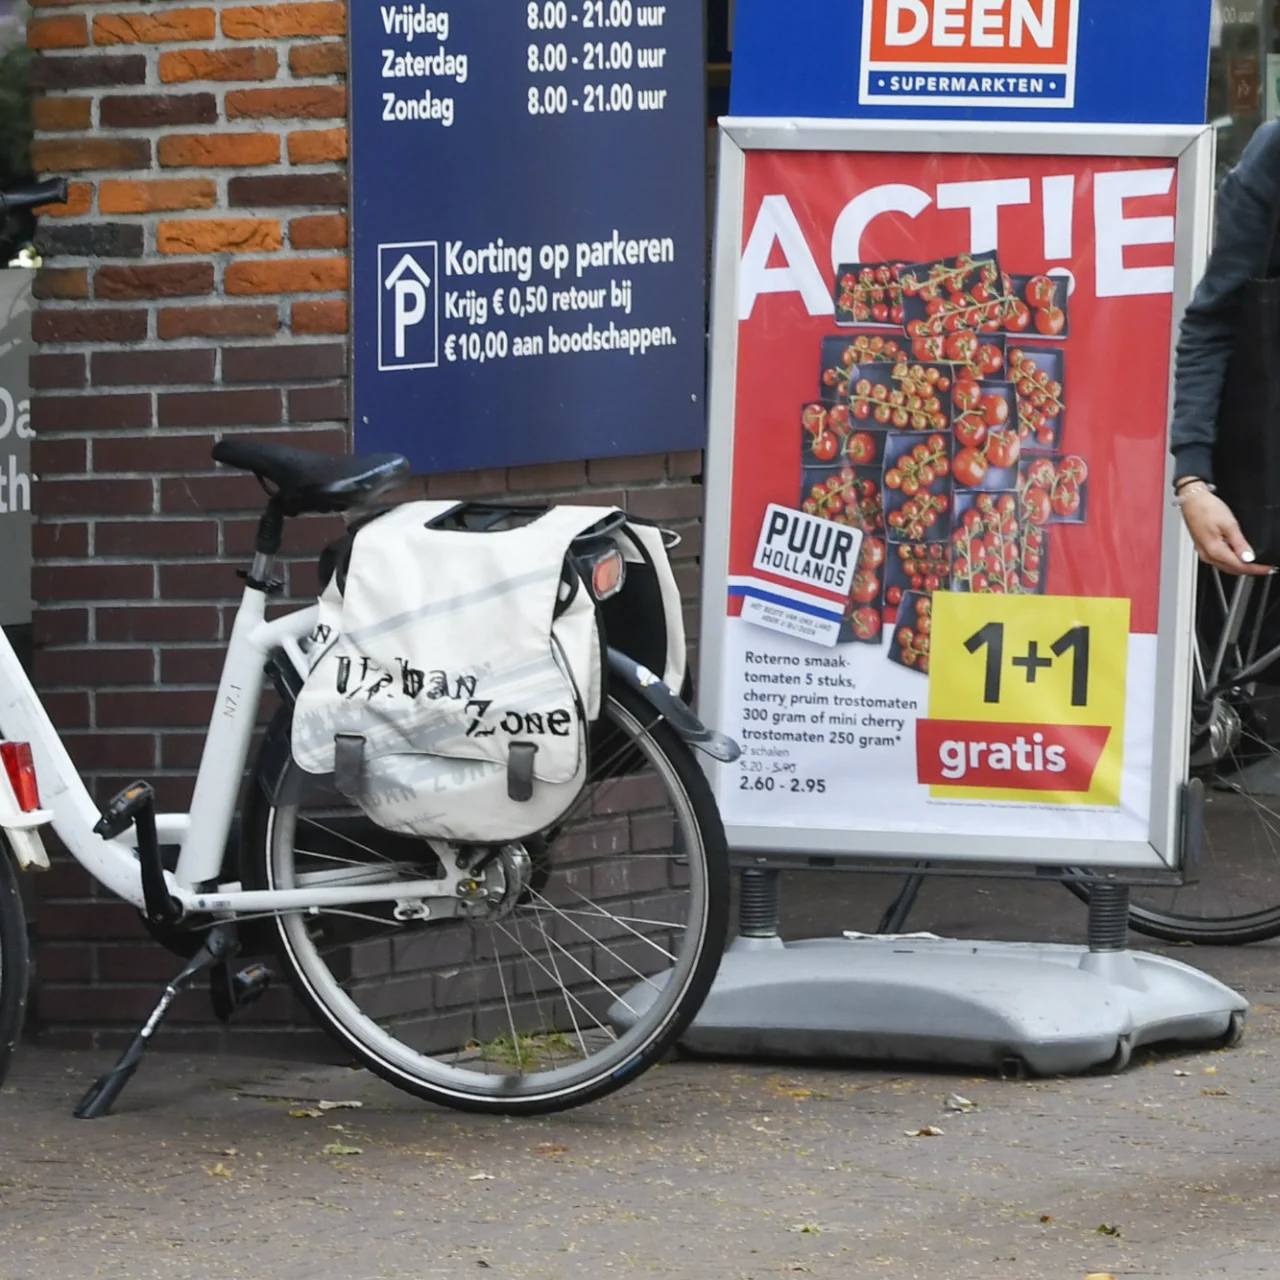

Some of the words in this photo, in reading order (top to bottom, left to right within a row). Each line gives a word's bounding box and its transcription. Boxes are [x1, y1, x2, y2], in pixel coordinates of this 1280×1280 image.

[380, 4, 449, 41] Vrijdag
[527, 1, 567, 30] 8.00
[582, 0, 632, 28] 21.00
[637, 5, 666, 27] uur
[382, 46, 468, 83] Zaterdag
[527, 43, 568, 72] 8.00
[583, 41, 633, 71] 21.00
[637, 47, 667, 69] uur
[890, 76, 1044, 94] SUPERMARKTEN
[382, 89, 454, 127] Zondag
[527, 85, 568, 115] 8.00
[583, 83, 633, 112] 21.00
[638, 89, 667, 110] uur
[445, 238, 532, 281] Korting
[538, 244, 570, 278] op
[576, 229, 674, 277] parkeren
[445, 290, 488, 325] Krijg
[493, 288, 504, 315] €
[508, 286, 548, 317] 0,50
[552, 286, 607, 311] retour
[611, 280, 632, 314] bij
[512, 335, 543, 356] aan
[548, 321, 677, 356] boodschappen.
[766, 510, 853, 568] PUUR
[760, 546, 846, 587] HOLLANDS
[745, 651, 800, 666] Roterno
[804, 655, 851, 668] smaak-
[963, 621, 1090, 707] 1+1
[743, 688, 786, 707] cherry
[790, 693, 829, 707] pruim
[834, 694, 917, 710] trostomaten
[744, 671, 801, 685] tomaten
[805, 673, 813, 686] 5
[817, 674, 856, 690] stuks,
[742, 728, 824, 743] trostomaten
[829, 732, 855, 745] 250
[743, 708, 768, 721] 300
[772, 713, 806, 726] gram
[810, 711, 825, 724] of
[829, 713, 857, 726] mini
[861, 715, 905, 732] cherry
[751, 747, 790, 757] schalen
[938, 733, 1066, 779] gratis
[739, 775, 775, 791] 2.60
[790, 778, 826, 793] 2.95
